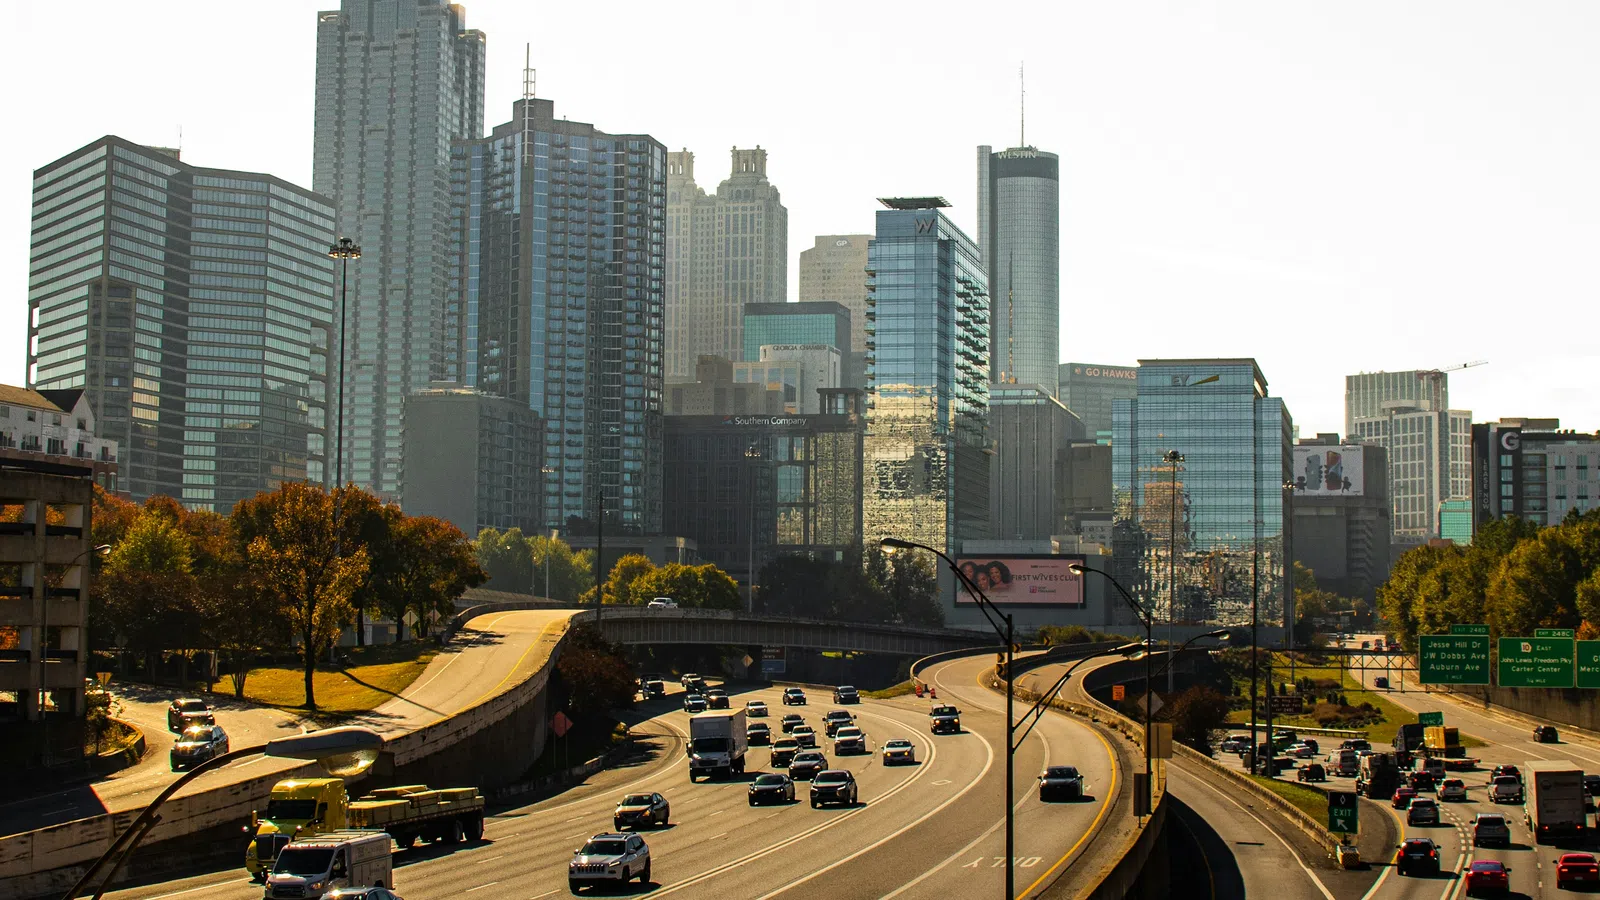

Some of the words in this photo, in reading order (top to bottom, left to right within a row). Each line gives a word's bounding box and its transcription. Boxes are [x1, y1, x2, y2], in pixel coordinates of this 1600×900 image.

[998, 151, 1036, 159] WESTIN
[914, 218, 936, 234] W
[1086, 368, 1100, 376] GO
[1102, 369, 1136, 380] HAWKS
[1171, 375, 1190, 387] EY
[735, 416, 770, 425] Southern
[770, 416, 806, 426] Company
[1501, 432, 1520, 450] G
[1032, 573, 1058, 581] WIVES
[1334, 808, 1352, 816] EXIT
